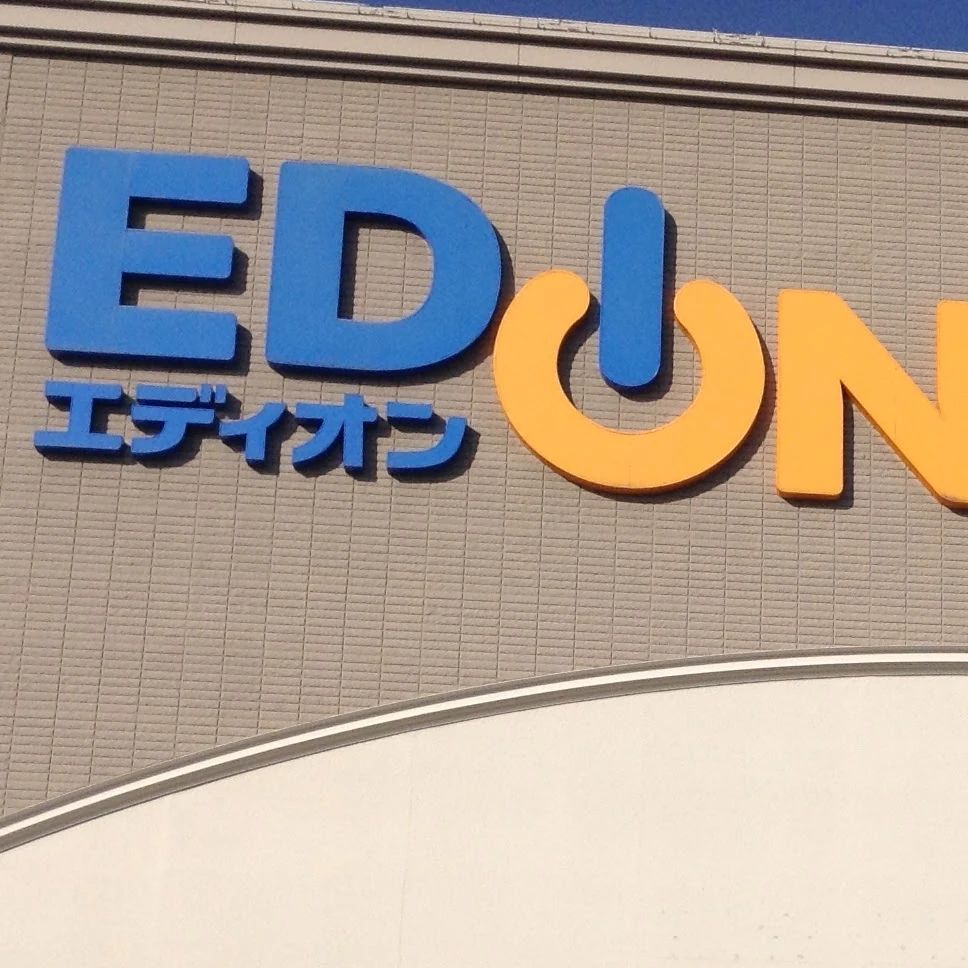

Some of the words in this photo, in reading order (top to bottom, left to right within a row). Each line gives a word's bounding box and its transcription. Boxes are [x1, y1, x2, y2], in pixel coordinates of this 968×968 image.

[34, 381, 468, 475] エディオン
